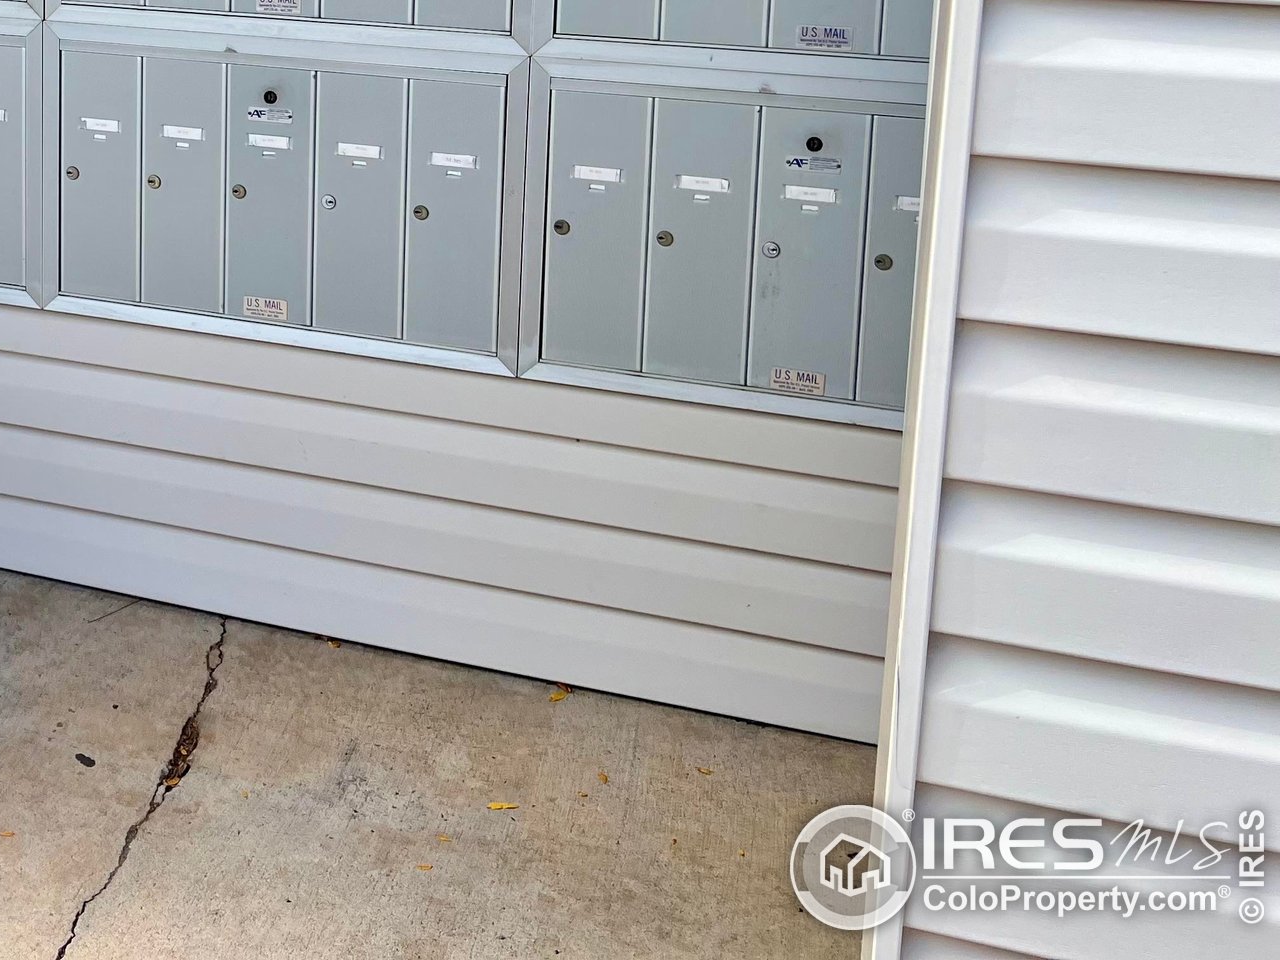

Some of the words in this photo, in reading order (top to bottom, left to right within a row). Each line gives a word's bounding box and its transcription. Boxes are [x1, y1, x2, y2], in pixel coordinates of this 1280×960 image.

[823, 27, 847, 40] MAIL
[264, 299, 283, 311] MAIL
[796, 371, 819, 385] MAIL
